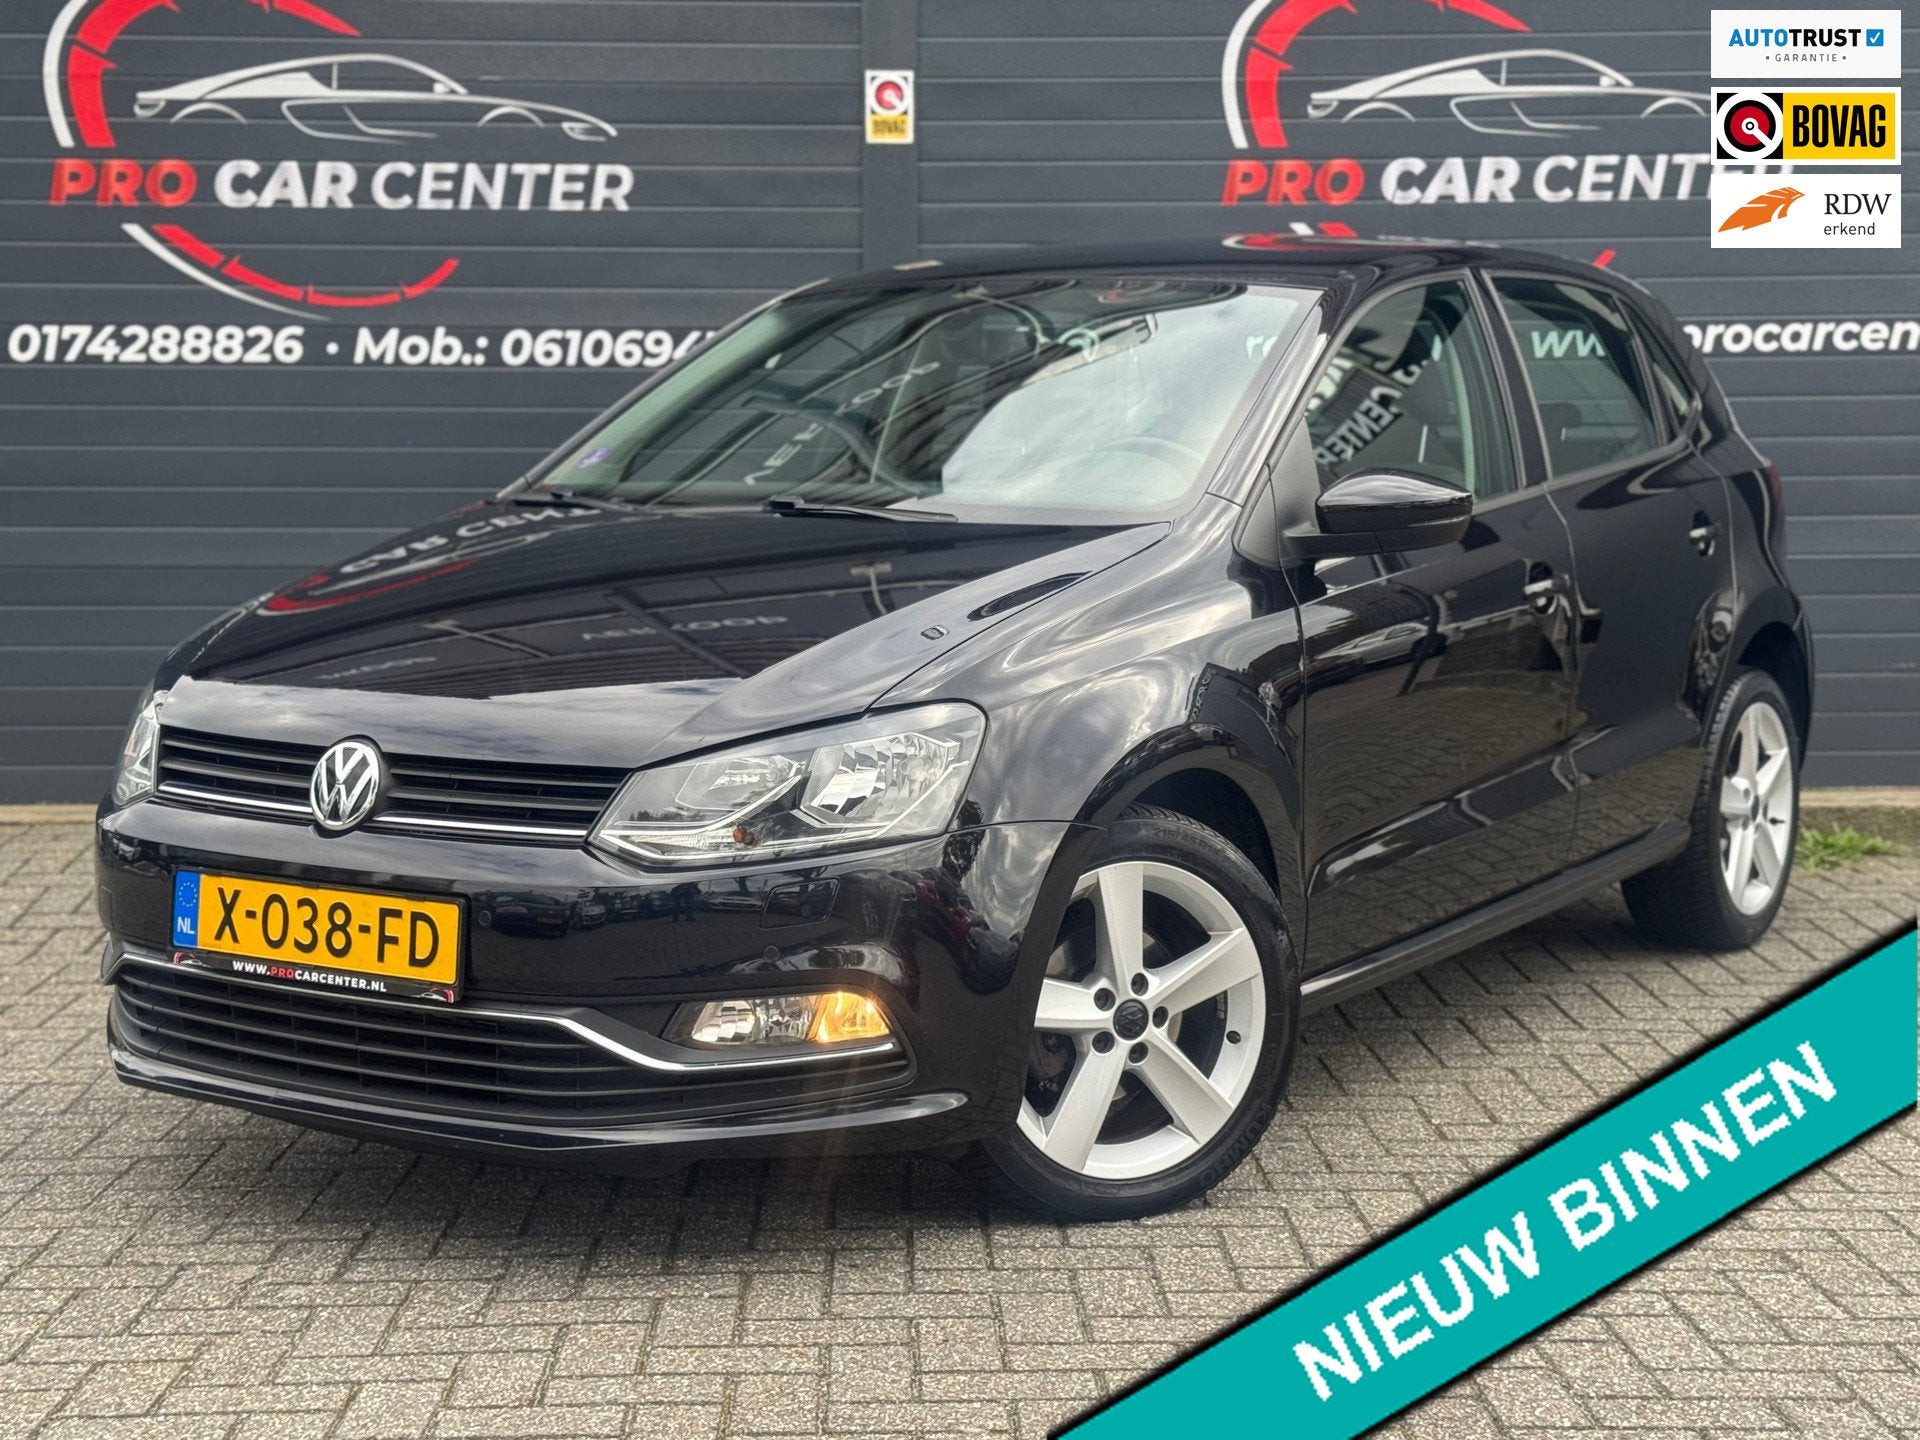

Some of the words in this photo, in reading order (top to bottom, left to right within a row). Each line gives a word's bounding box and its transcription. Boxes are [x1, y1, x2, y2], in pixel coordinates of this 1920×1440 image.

[50, 158, 197, 207] PRO
[214, 159, 359, 209] CAR
[371, 161, 635, 212] CENTER
[1222, 157, 1365, 206] PRO
[1380, 156, 1521, 205] CAR
[8, 324, 304, 364] 0174288826
[353, 326, 488, 366] Mob.:
[176, 916, 196, 935] NL
[214, 887, 439, 968] X-038-FD
[232, 960, 387, 993] WWW.PROCARCENTER.NL
